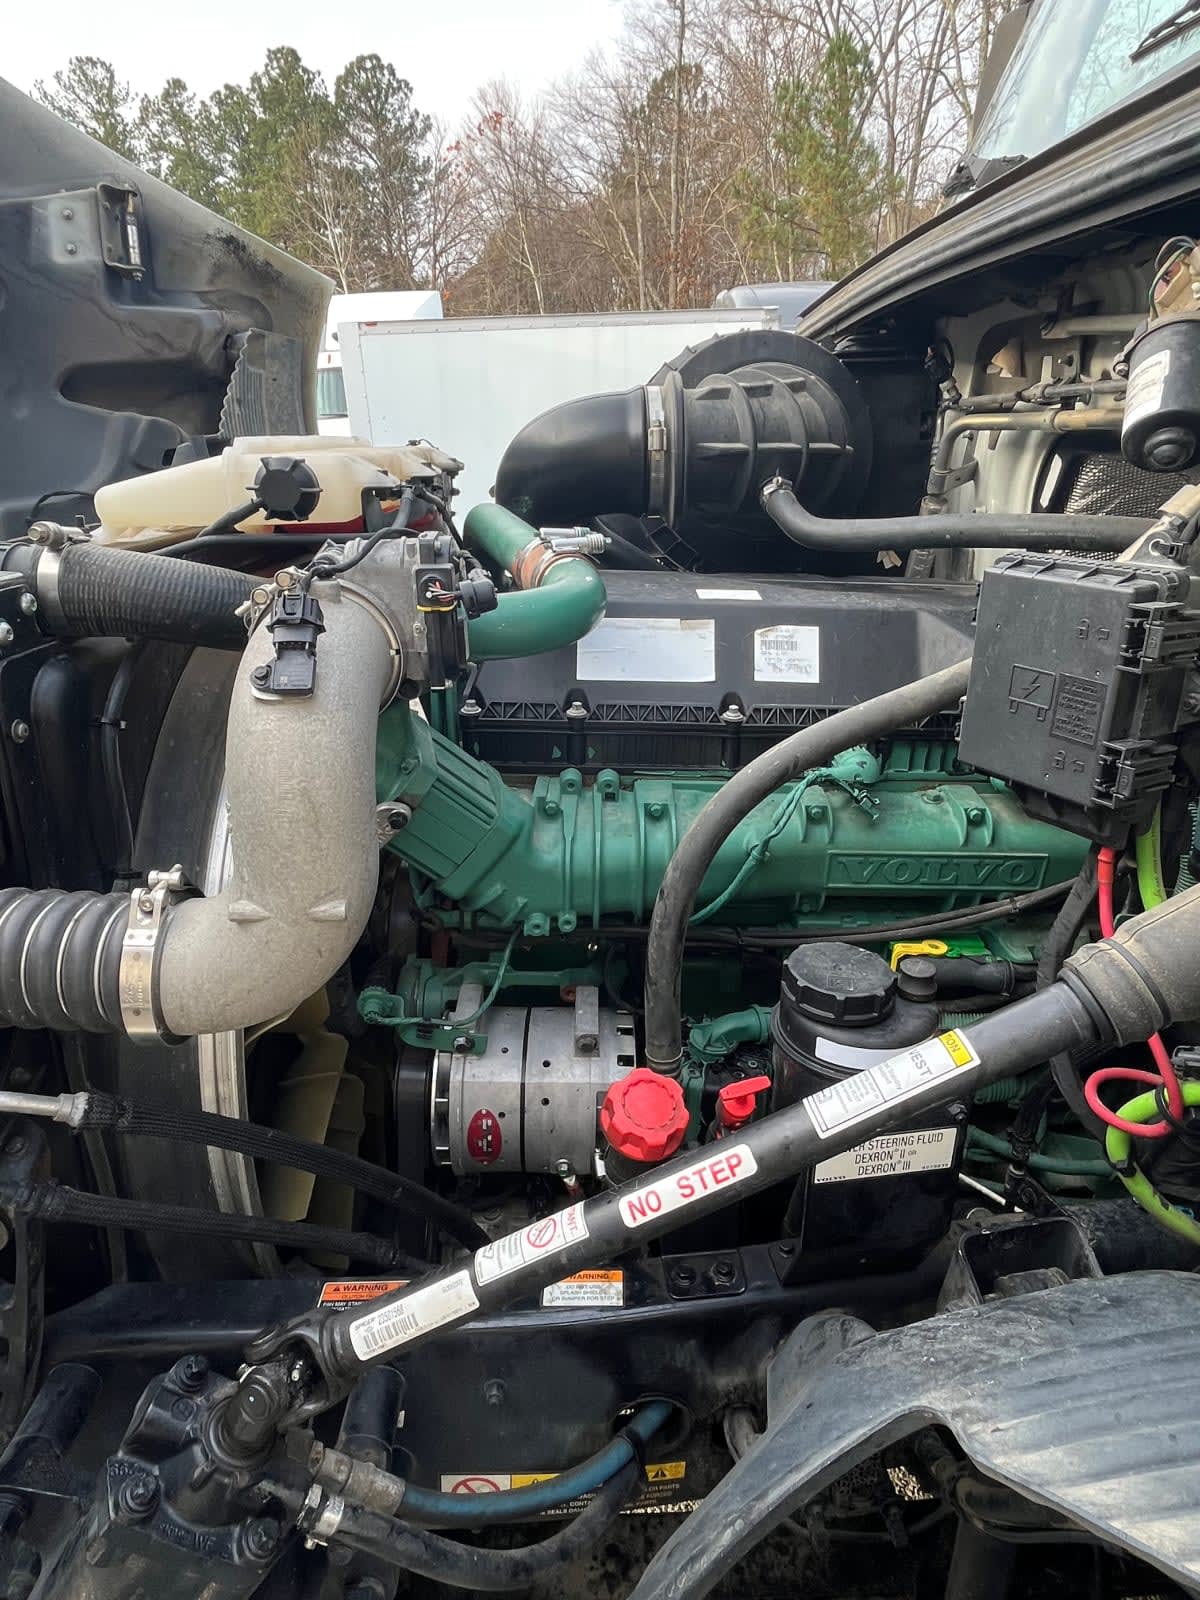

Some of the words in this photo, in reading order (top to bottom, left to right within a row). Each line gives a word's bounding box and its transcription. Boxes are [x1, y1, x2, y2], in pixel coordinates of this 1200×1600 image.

[836, 856, 1036, 884] VOLVO
[868, 1135, 915, 1151] STEERING
[916, 1132, 944, 1145] FLUID
[627, 1190, 662, 1223] NO
[676, 1153, 743, 1199] STEP
[343, 1284, 388, 1292] WARNING
